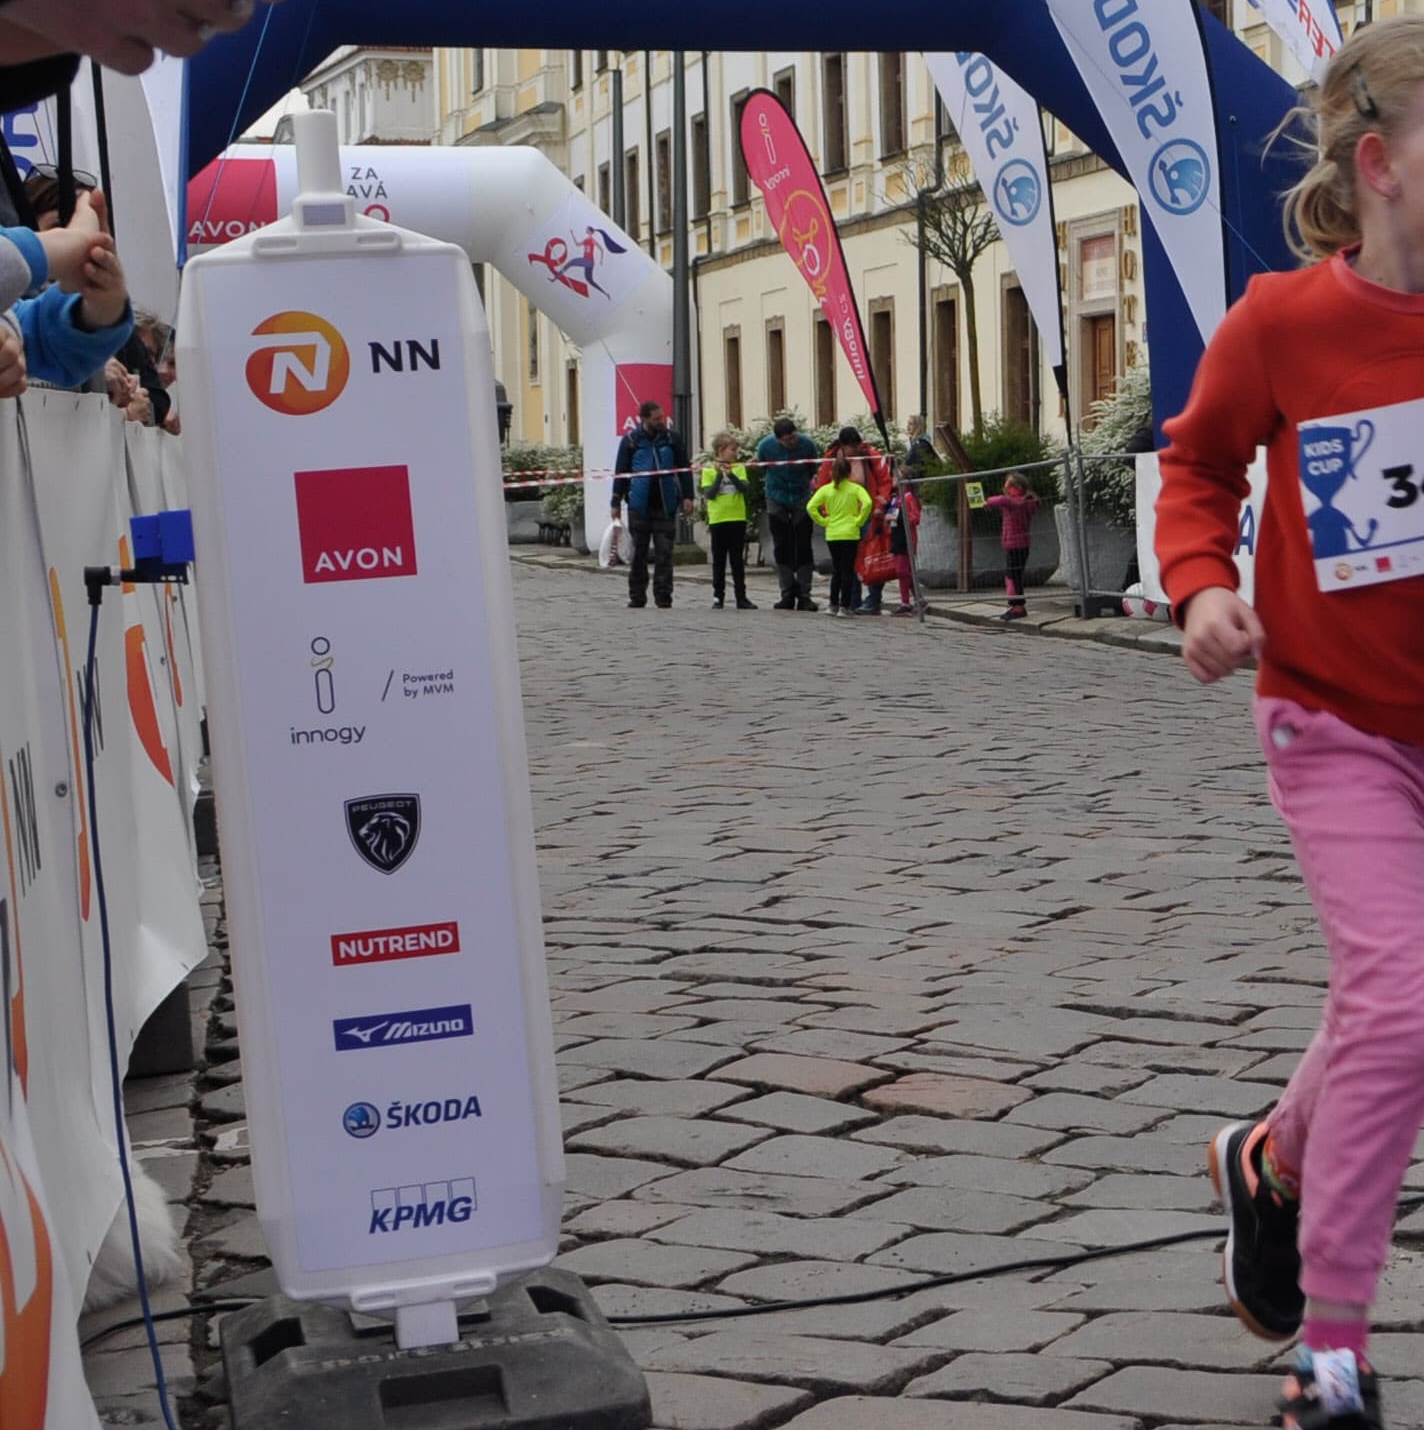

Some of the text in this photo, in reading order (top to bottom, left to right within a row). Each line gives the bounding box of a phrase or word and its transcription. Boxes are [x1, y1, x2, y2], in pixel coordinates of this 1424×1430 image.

[347, 182, 387, 199] AVÁ
[368, 339, 440, 373] NN
[1304, 438, 1344, 457] KIDS
[1307, 458, 1343, 475] CUP
[314, 546, 403, 572] AVON
[403, 669, 454, 683] Powered
[404, 684, 454, 699] by MVM
[290, 726, 366, 745] innogy
[338, 929, 454, 959] NUTREND
[386, 1096, 482, 1129] ŠKODA
[369, 1197, 472, 1234] KPMG
